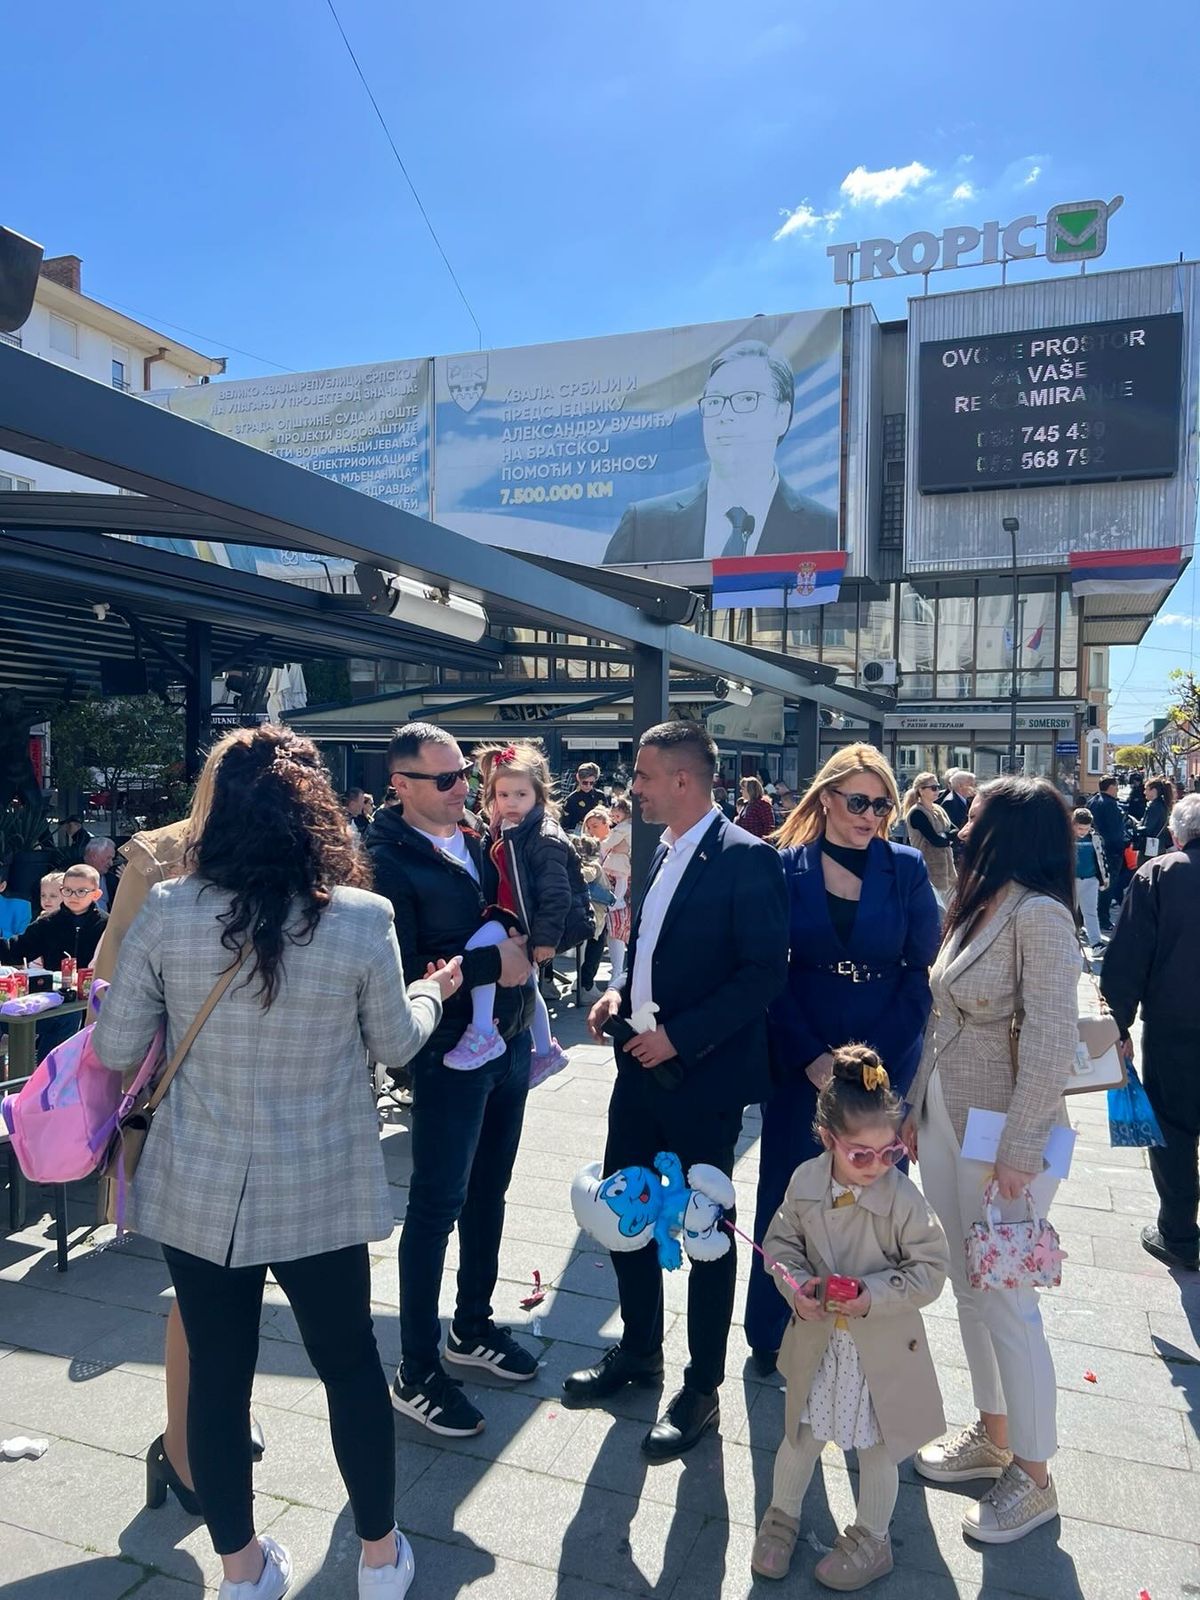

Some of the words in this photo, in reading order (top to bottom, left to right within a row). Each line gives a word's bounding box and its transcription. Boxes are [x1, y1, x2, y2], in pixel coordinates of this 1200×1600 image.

[827, 215, 1037, 284] TROPIC
[365, 367, 418, 384] СРПСКОЈ
[1027, 357, 1088, 383] VAŠE
[345, 389, 362, 402] ОД
[502, 385, 554, 403] ХВАЛА
[559, 376, 621, 397] СРБИЈИ
[626, 376, 638, 392] И
[335, 411, 364, 425] СУДА
[368, 410, 376, 422] И
[379, 405, 418, 420] ПОШТЕ
[502, 397, 626, 422] ПРЕДСЈЕДНИКУ
[276, 429, 333, 444] ПРОЈЕКТИ
[335, 421, 418, 440] ВОДОЗАШТИТЕ
[502, 419, 607, 443] АЛЕКСАНДРУ
[611, 412, 677, 432] ВУЧИЋУ
[1021, 425, 1060, 443] 745
[296, 437, 418, 458] ВОДОСНАБДИЈЕВАЊА
[502, 449, 523, 463] НА
[527, 438, 609, 460] БРАТСКОЈ
[313, 452, 419, 471] ЕЛЕКТРИФИКАЦИЈЕ
[501, 463, 572, 481] ПОМОЋИ
[577, 461, 588, 476] У
[590, 454, 658, 474] ИЗНОСУ
[1021, 450, 1059, 469] 568
[363, 484, 417, 498] ЗДРАВЉА
[500, 483, 583, 505] 7.500.000
[1028, 718, 1071, 728] SOMERSBY
